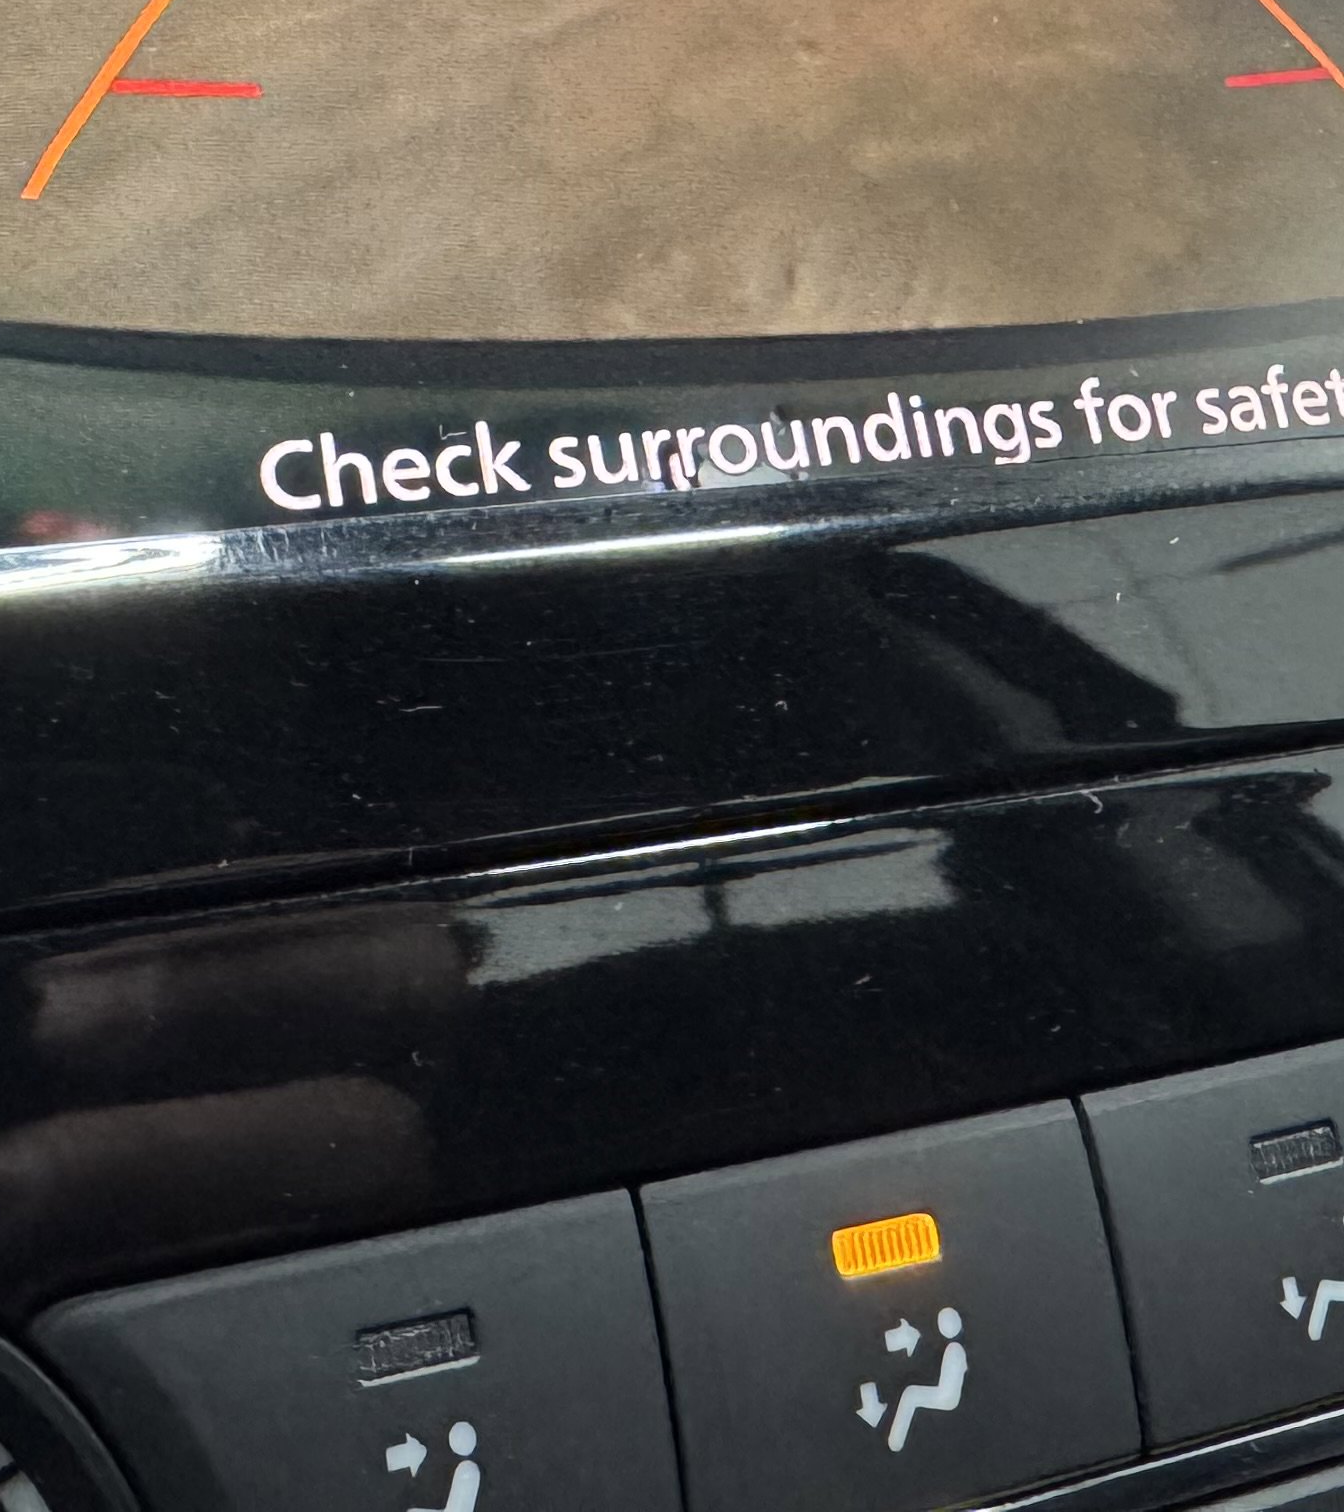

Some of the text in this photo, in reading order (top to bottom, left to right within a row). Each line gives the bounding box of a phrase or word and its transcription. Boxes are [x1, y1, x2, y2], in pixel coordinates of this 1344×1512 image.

[259, 420, 532, 510] Check
[548, 391, 1064, 490] surroundings
[1073, 376, 1177, 445] for
